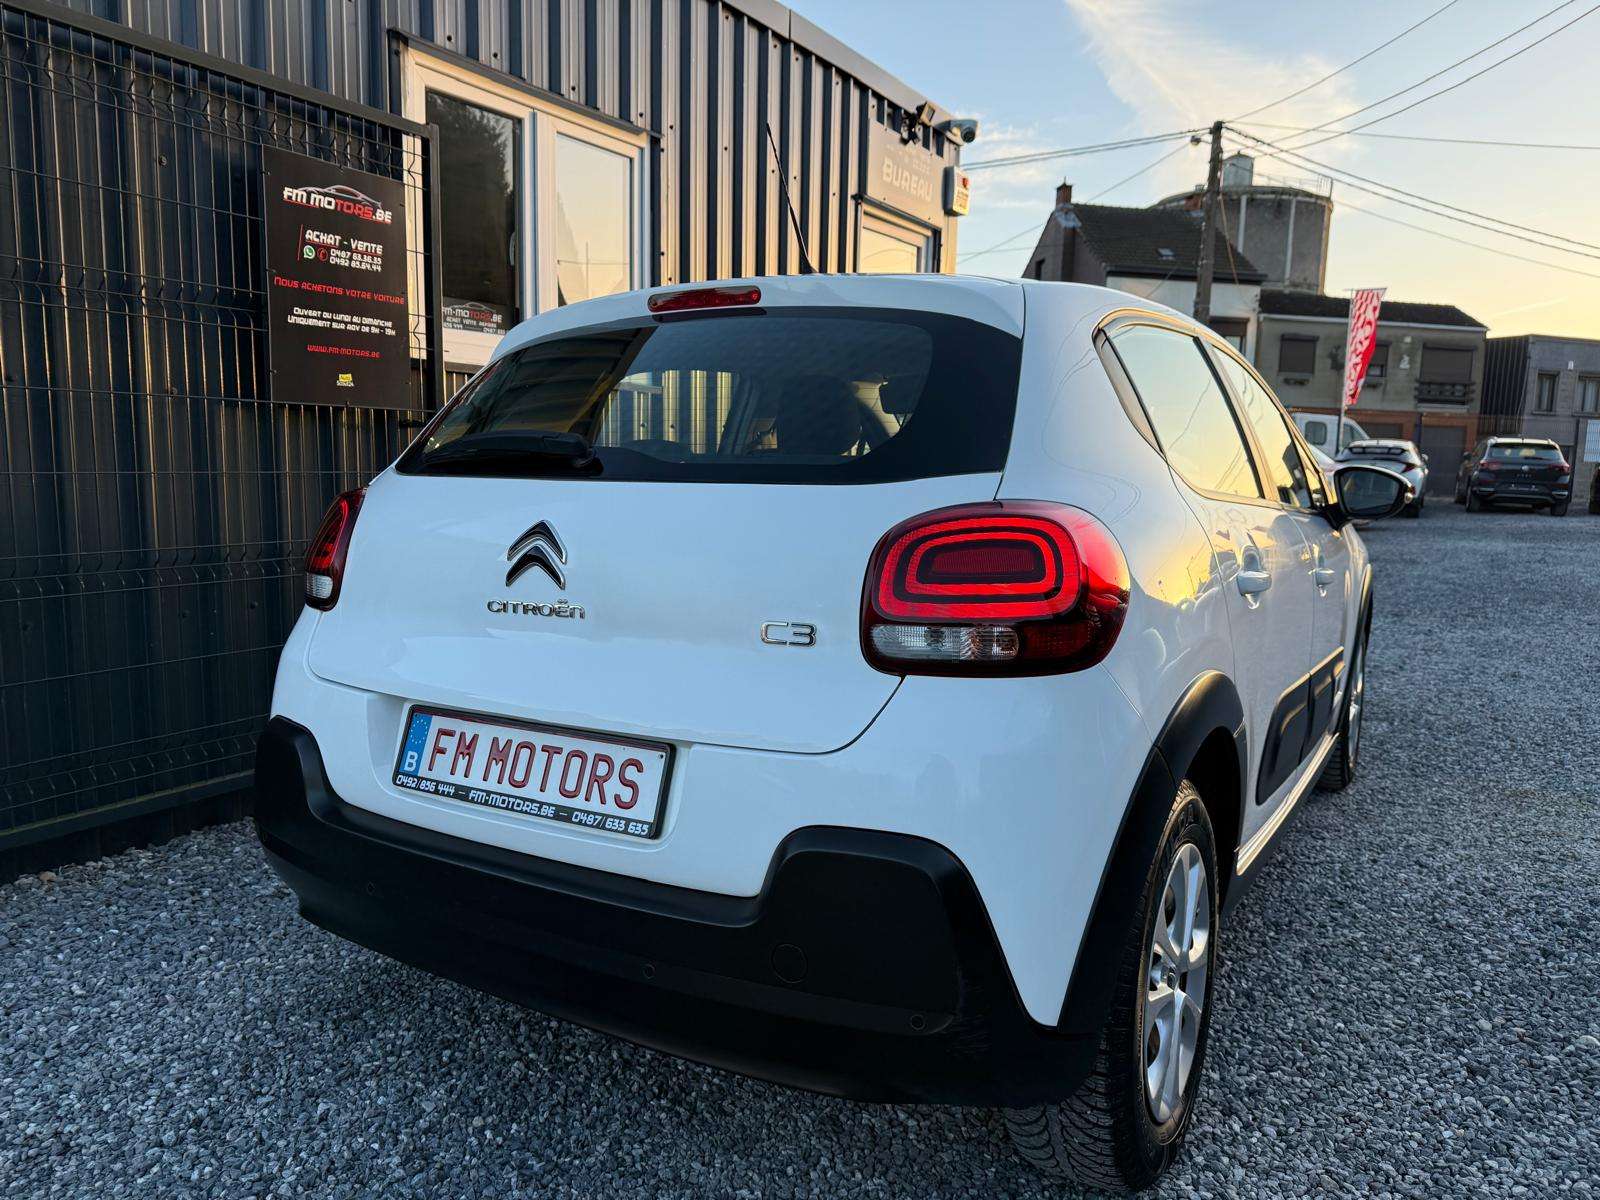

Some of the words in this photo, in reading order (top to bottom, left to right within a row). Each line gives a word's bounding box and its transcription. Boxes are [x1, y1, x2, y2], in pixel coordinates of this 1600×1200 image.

[882, 157, 933, 202] BUREAU
[283, 186, 307, 203] FM
[310, 193, 393, 223] MOTORS.BE
[305, 229, 341, 247] ACHAT
[351, 238, 383, 255] VENTE
[330, 248, 351, 259] 0487
[329, 256, 350, 267] 0492
[761, 620, 817, 647] C3
[403, 750, 418, 772] B
[428, 727, 479, 778] FM
[483, 736, 644, 810] MOTORS
[469, 789, 556, 818] FM-MOTORS.BE
